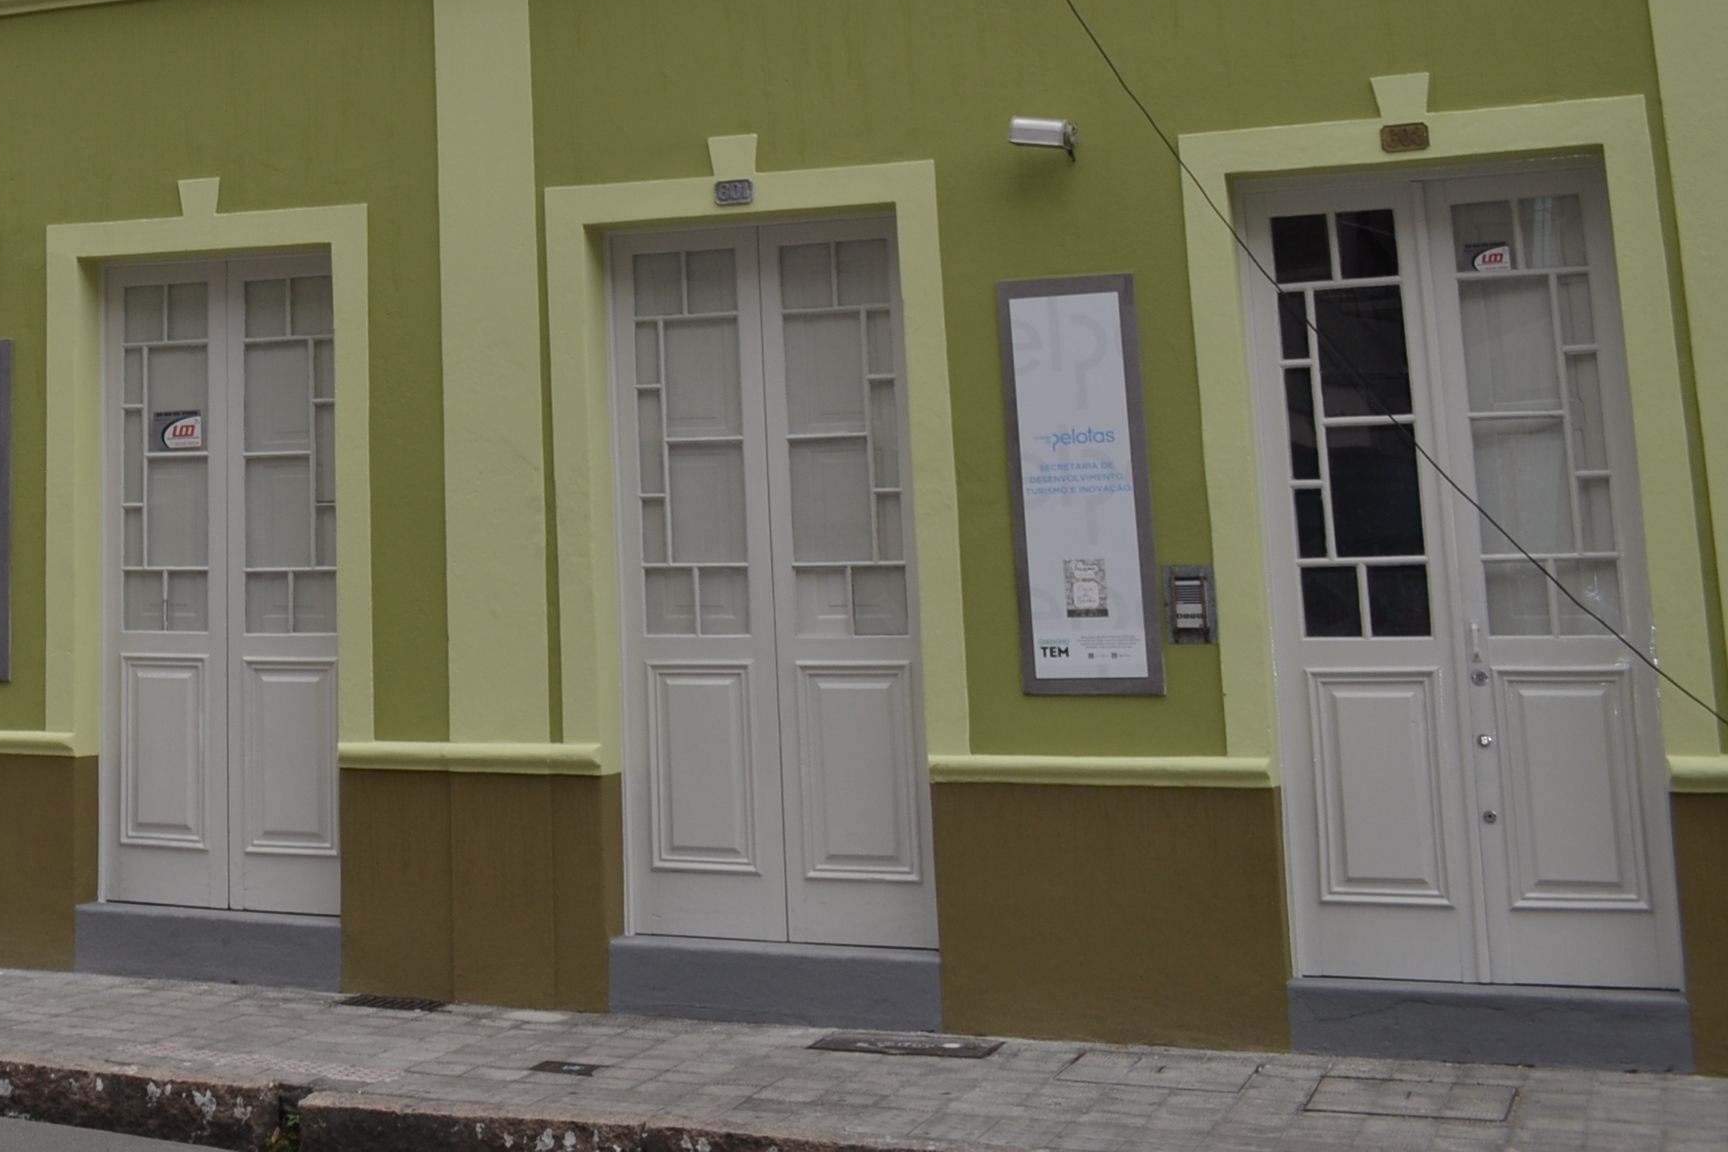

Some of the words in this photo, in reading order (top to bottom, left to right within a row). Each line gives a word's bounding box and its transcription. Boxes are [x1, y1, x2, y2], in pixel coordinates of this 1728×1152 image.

[1039, 462, 1098, 473] SECRETARIA
[1100, 461, 1114, 470] DE
[1026, 486, 1068, 496] TURISMO
[1079, 483, 1131, 494] INOVAÇÃO
[1040, 646, 1070, 659] TEM
